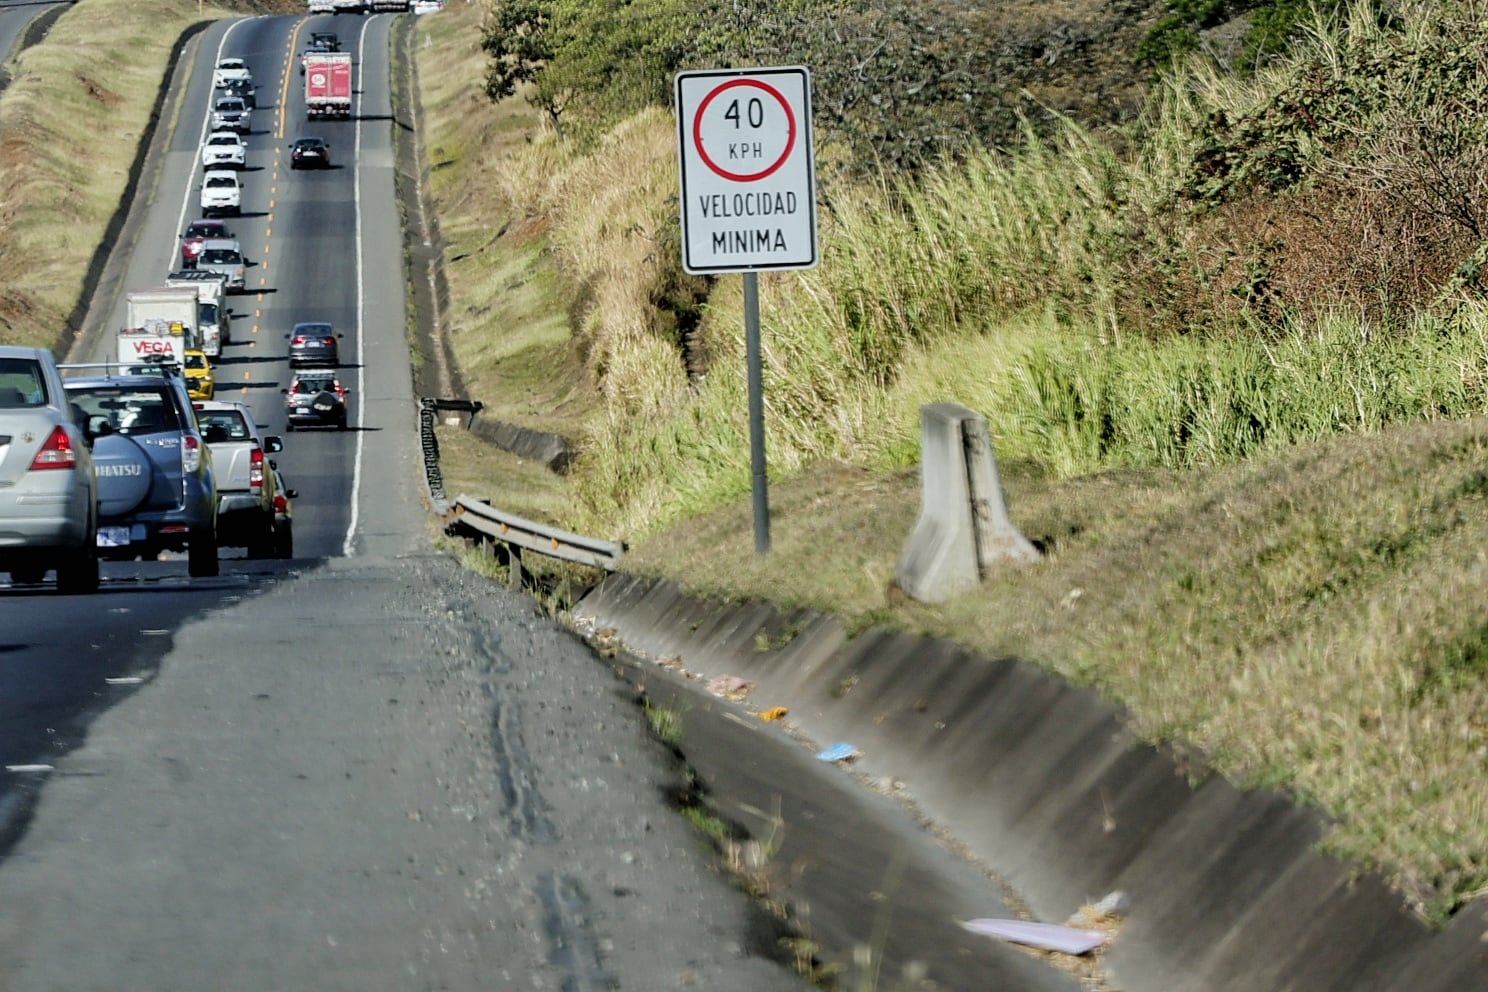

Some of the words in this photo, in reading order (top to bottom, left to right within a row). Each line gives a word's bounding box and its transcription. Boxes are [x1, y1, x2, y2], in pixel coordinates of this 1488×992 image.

[724, 97, 764, 130] 40
[728, 142, 763, 159] KPH
[699, 191, 798, 218] VELOCIDAD
[712, 228, 788, 255] MINIMA
[132, 340, 174, 354] VEGA
[95, 464, 142, 477] IHATSU
